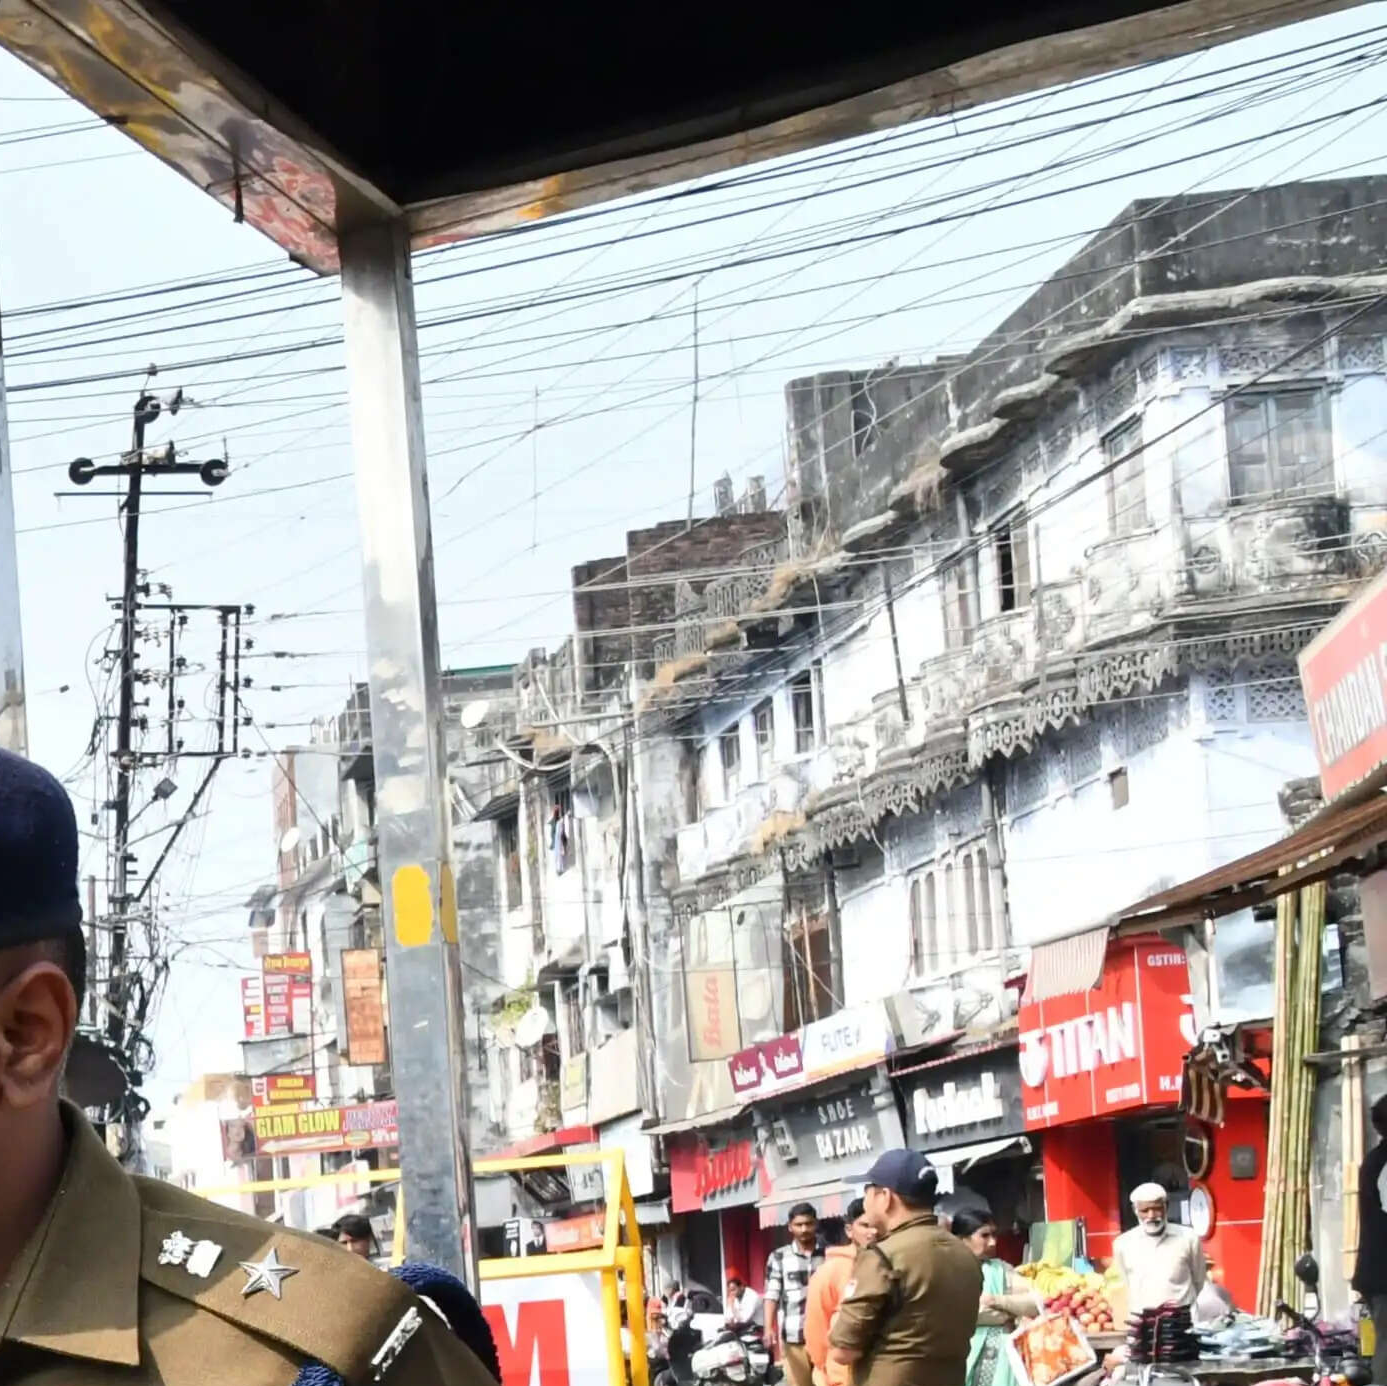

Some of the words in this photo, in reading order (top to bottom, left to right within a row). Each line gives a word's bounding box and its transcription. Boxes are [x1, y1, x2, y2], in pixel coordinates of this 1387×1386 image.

[1048, 1001, 1137, 1079] TITAN
[257, 1115, 296, 1138] GLAM
[298, 1109, 340, 1133] GLOW
[818, 1099, 856, 1125] SHOE
[815, 1126, 873, 1160] BAZAAR
